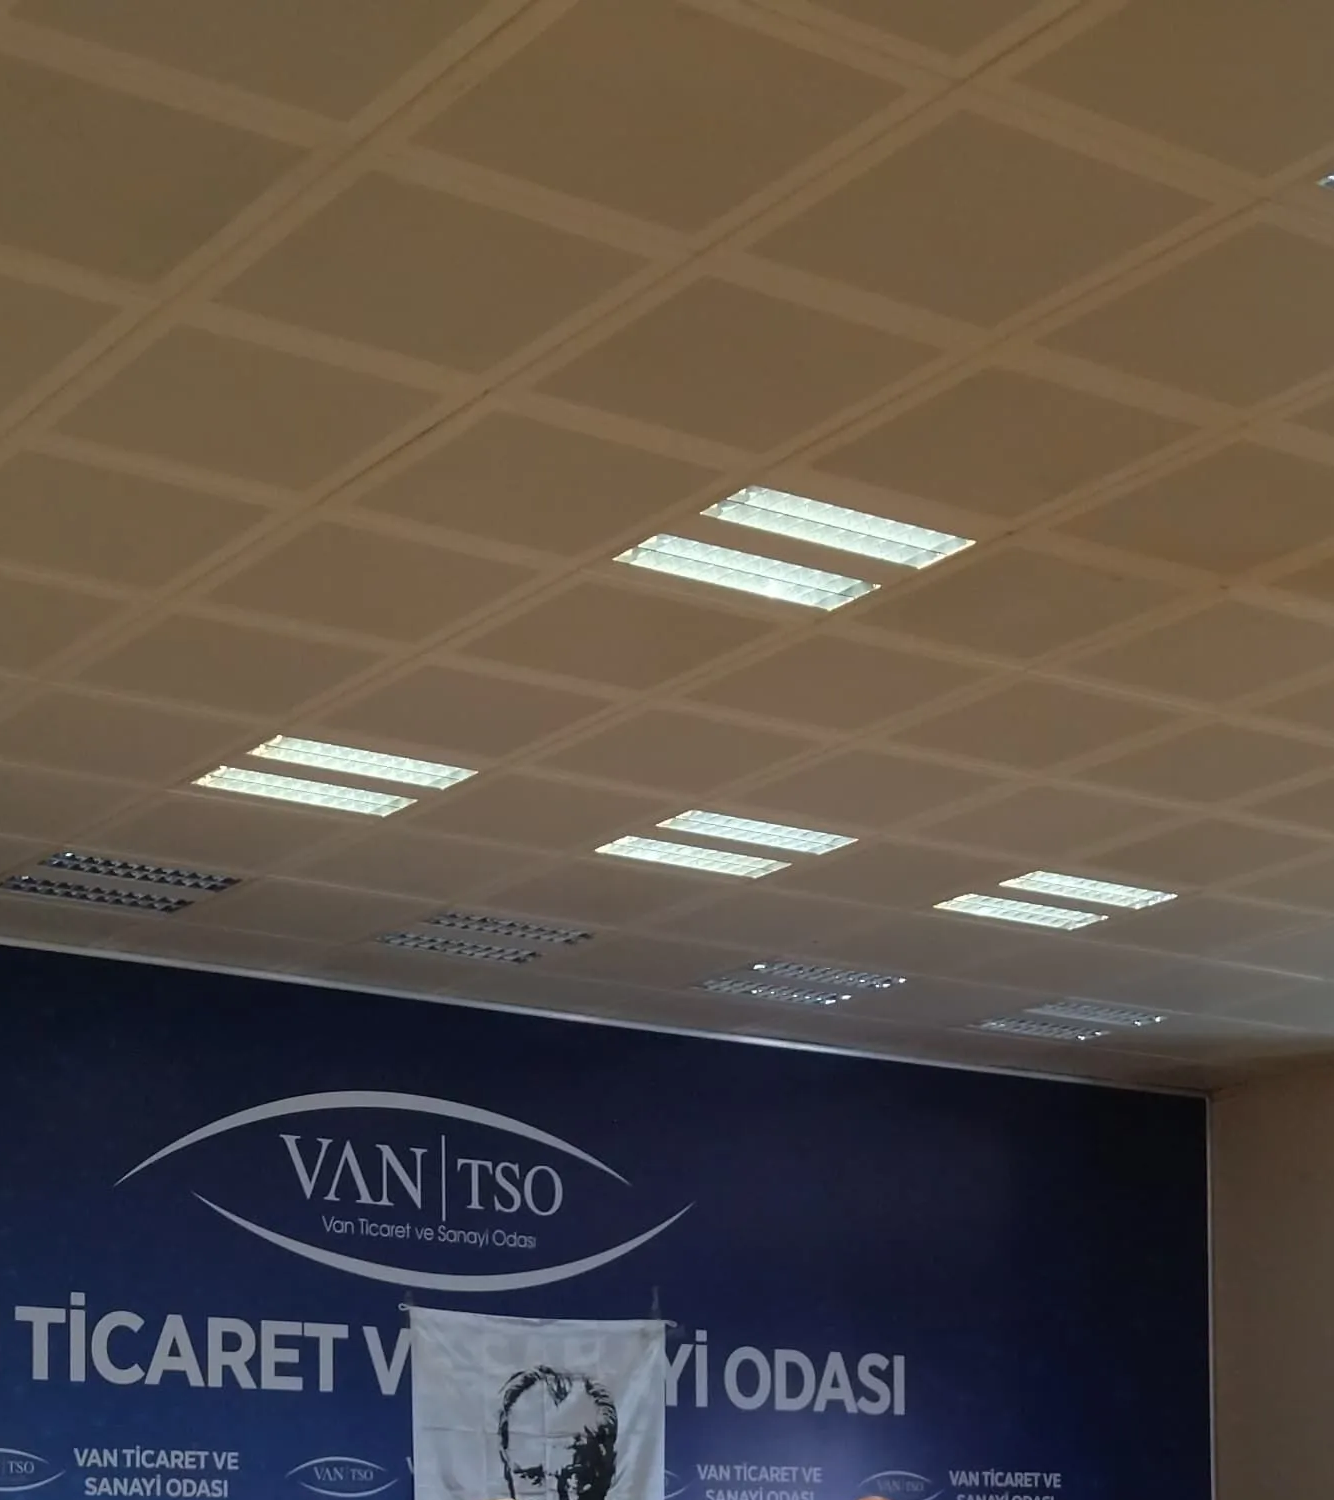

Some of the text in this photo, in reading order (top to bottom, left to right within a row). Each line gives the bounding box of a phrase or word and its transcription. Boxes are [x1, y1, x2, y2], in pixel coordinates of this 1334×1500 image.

[279, 1134, 564, 1216] VAN TSO
[321, 1215, 537, 1249] Van Ticaret ve Sanayi Odası
[14, 1291, 349, 1393] TİCARET
[363, 1326, 412, 1395] V
[724, 1346, 906, 1415] ODASI
[7, 1461, 35, 1474] TSO
[74, 1445, 239, 1470] VAN TİCARET VE
[313, 1466, 374, 1481] VAN TSO
[697, 1461, 823, 1483] VAN TİCARET VE
[948, 1468, 1062, 1488] VAN TİCARET VE
[84, 1474, 228, 1498] SANAYİ ODASI
